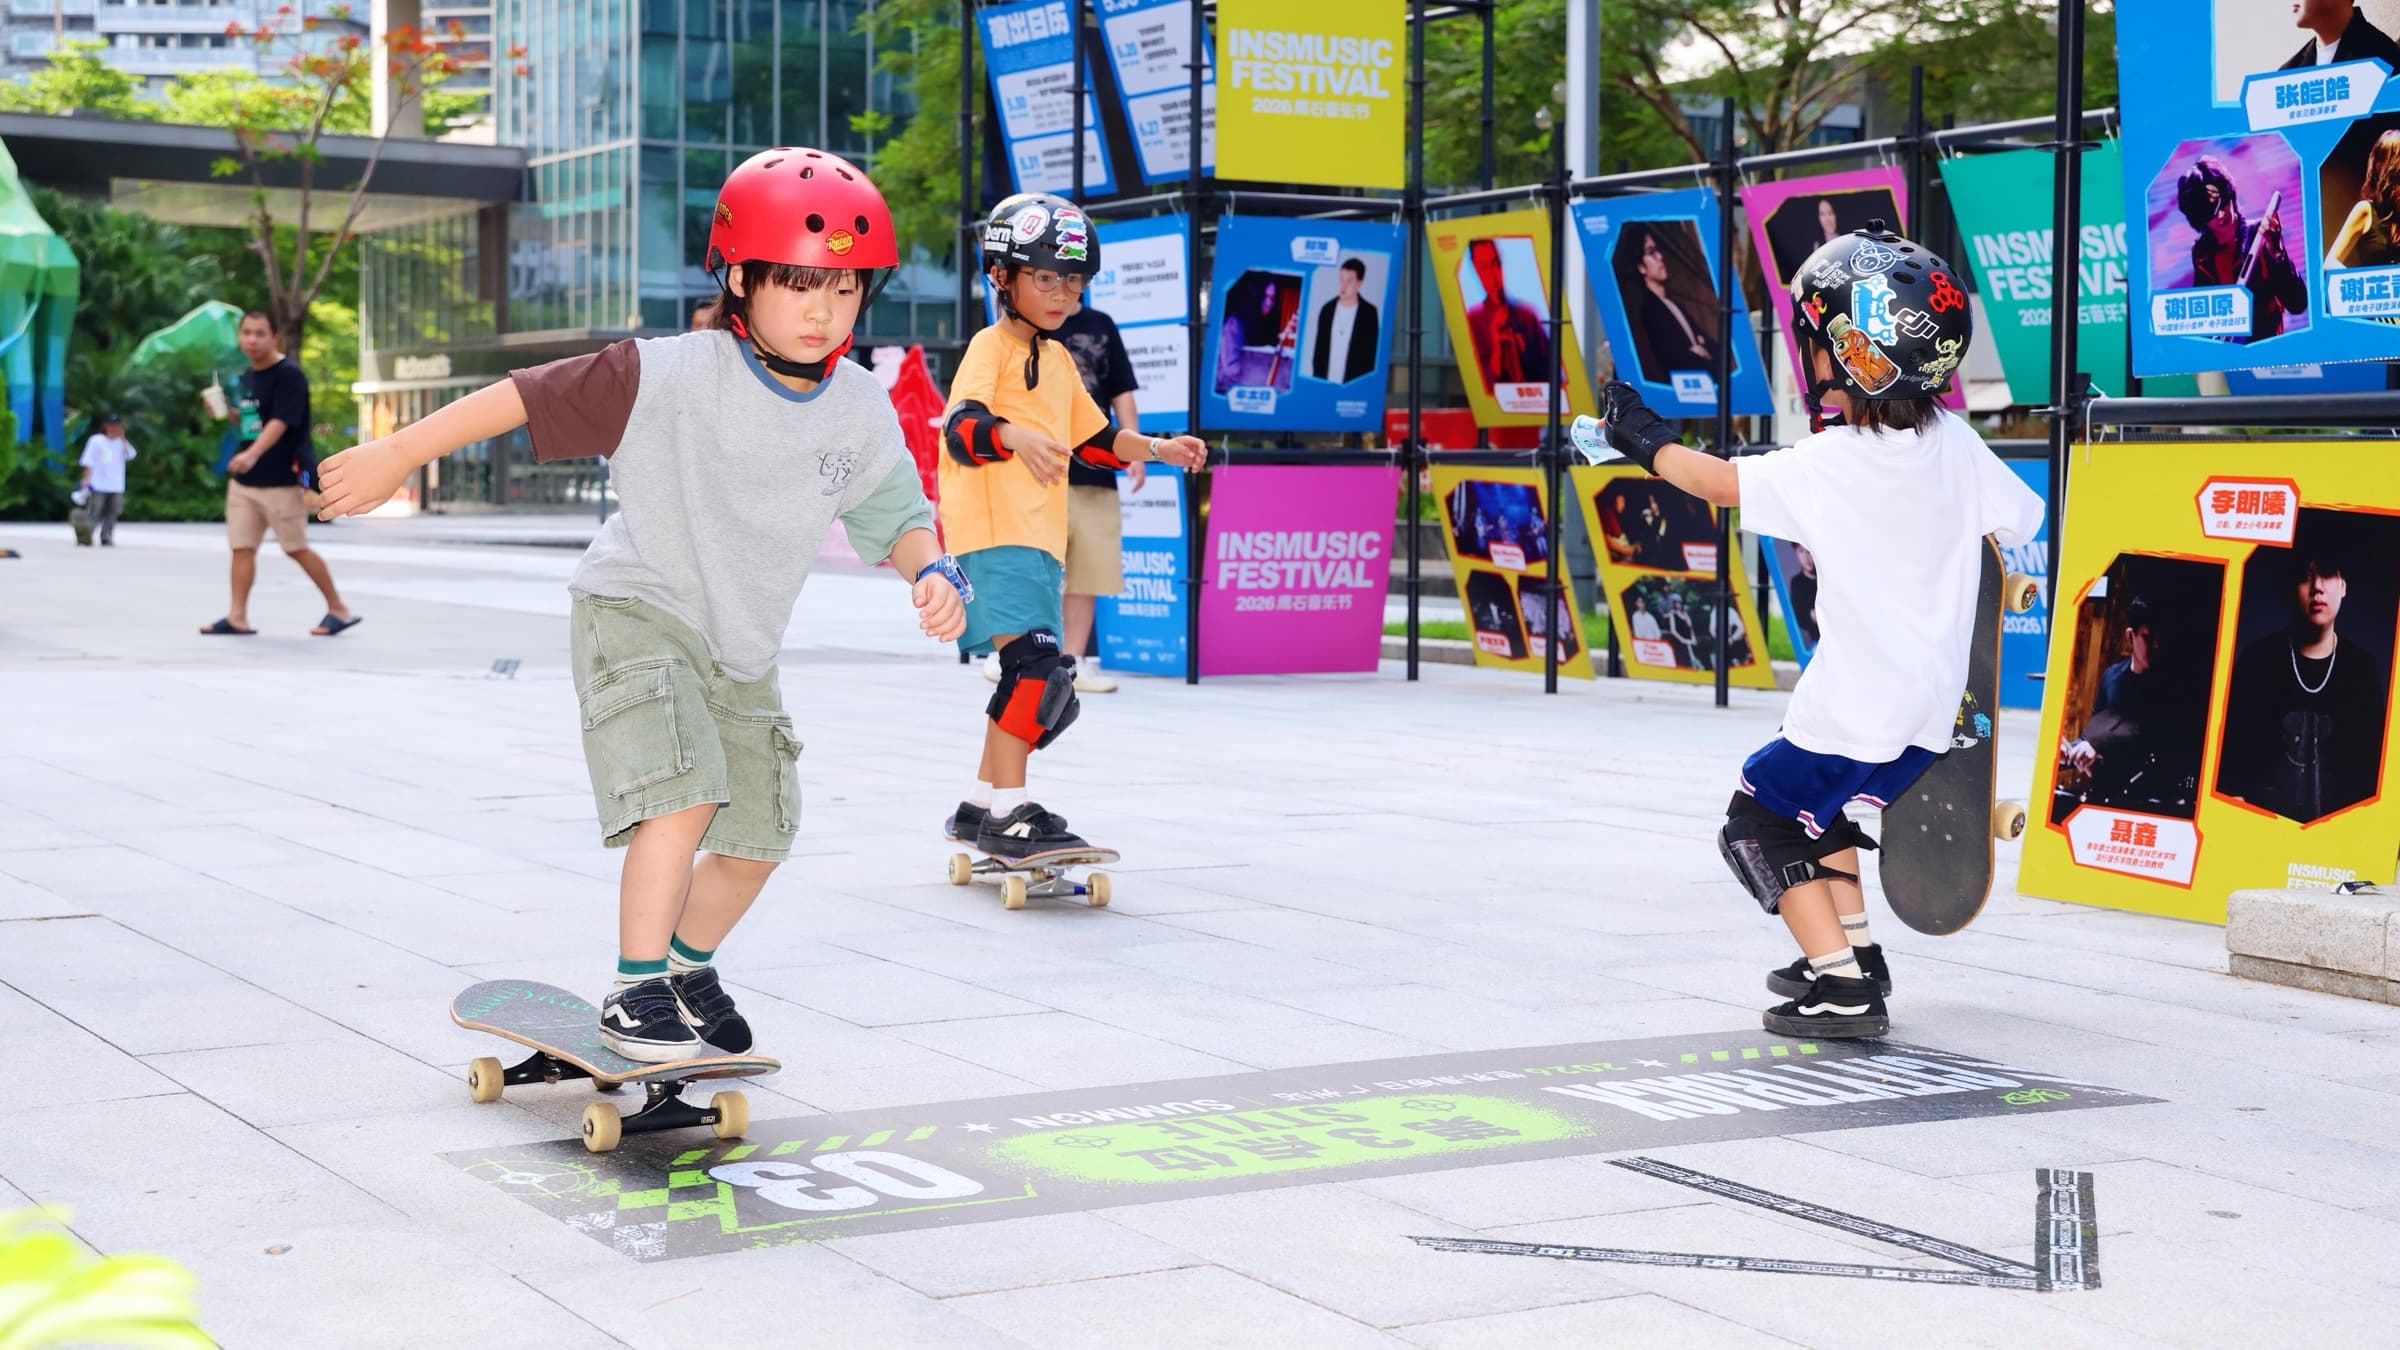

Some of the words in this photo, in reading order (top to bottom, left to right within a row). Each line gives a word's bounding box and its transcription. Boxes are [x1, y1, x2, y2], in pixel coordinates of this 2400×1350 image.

[1228, 27, 1393, 68] INSMUSIC
[1232, 60, 1389, 98] FESTIVAL
[1252, 97, 1293, 115] 2026
[1973, 222, 2127, 267] INSMSI
[1986, 261, 2127, 302] FESVA
[2078, 303, 2127, 324] 石音乐
[2164, 294, 2234, 320] 谢固原
[1217, 531, 1381, 560] INSMUSIC
[1121, 551, 1176, 576] SMUSIC
[1217, 561, 1373, 590] FESTIVAL
[1110, 577, 1178, 602] STIVAL
[1235, 595, 1275, 612] 2026
[2003, 615, 2042, 634] 2026
[2109, 818, 2158, 848] 聂鑫
[2288, 862, 2356, 881] INSMUSIC
[1373, 1070, 1525, 1093] 世界滑板日
[1524, 1061, 1628, 1077] 2026
[1269, 1084, 1369, 1103] 广州站
[1541, 1056, 2023, 1121] CITYTRACK
[1011, 1098, 1236, 1131] SUMMON
[1136, 1104, 1370, 1141] STYLE
[1114, 1112, 1522, 1173] 第3点位
[709, 1150, 984, 1211] 03
